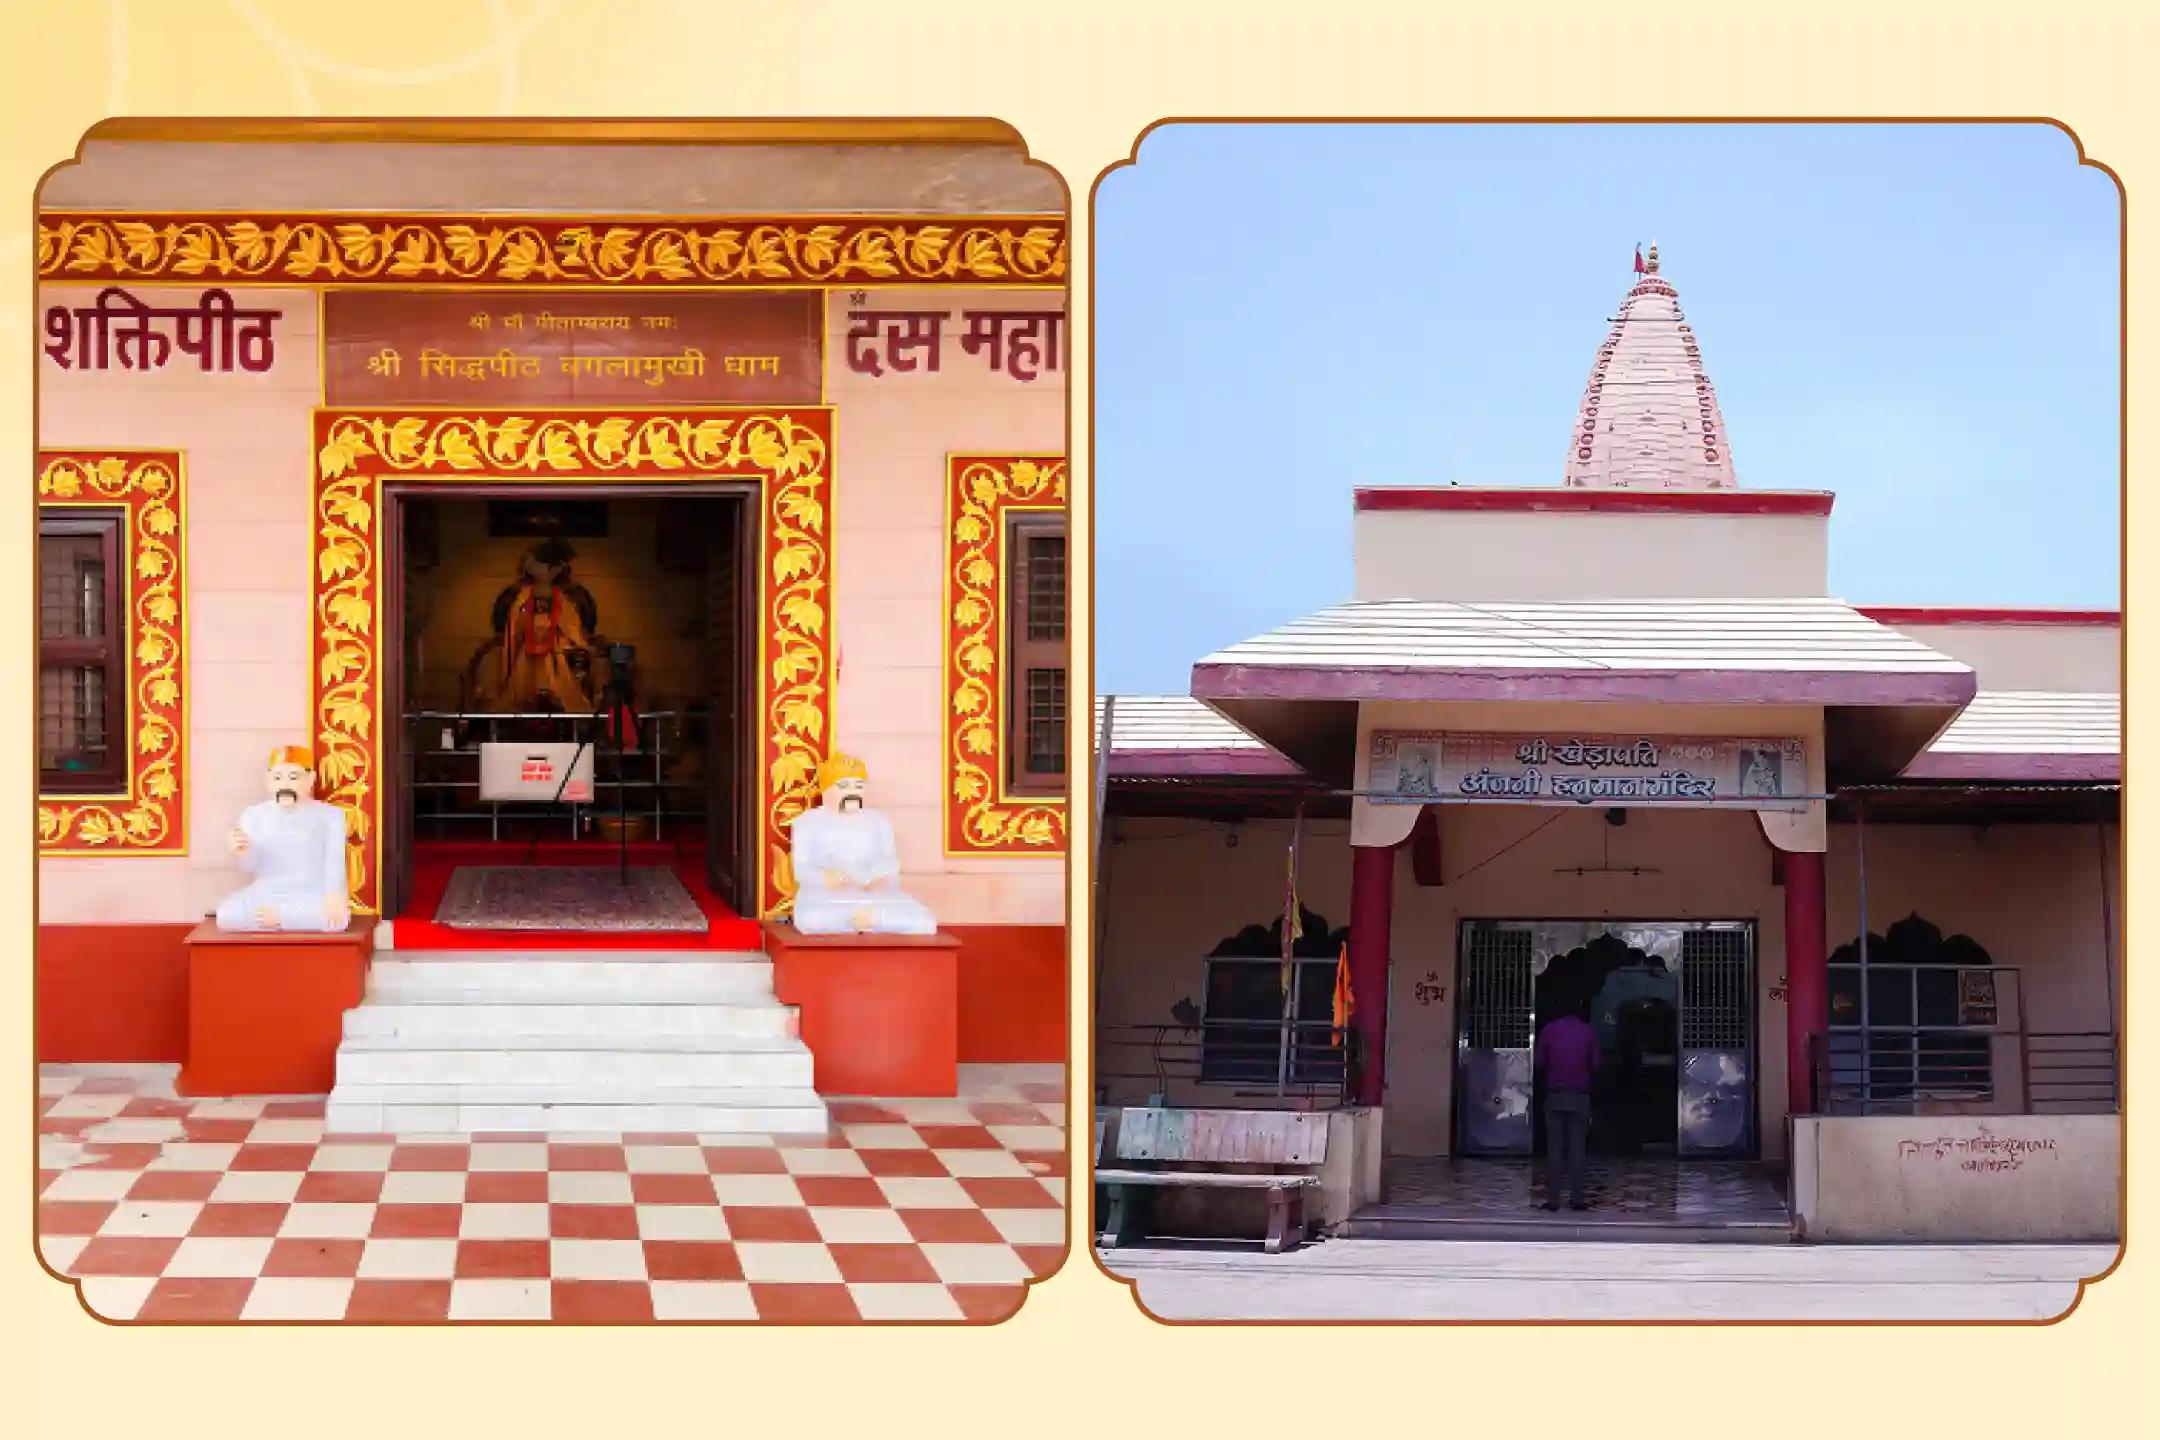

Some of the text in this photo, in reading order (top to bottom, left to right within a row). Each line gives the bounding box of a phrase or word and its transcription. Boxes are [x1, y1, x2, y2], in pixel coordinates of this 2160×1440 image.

[45, 287, 282, 372] शक्तिपीठ
[848, 311, 951, 377] दस
[367, 348, 402, 377] श्री
[419, 348, 542, 381] सिद्धपीठ
[724, 355, 781, 377] धाम
[1516, 737, 1549, 764] श्री
